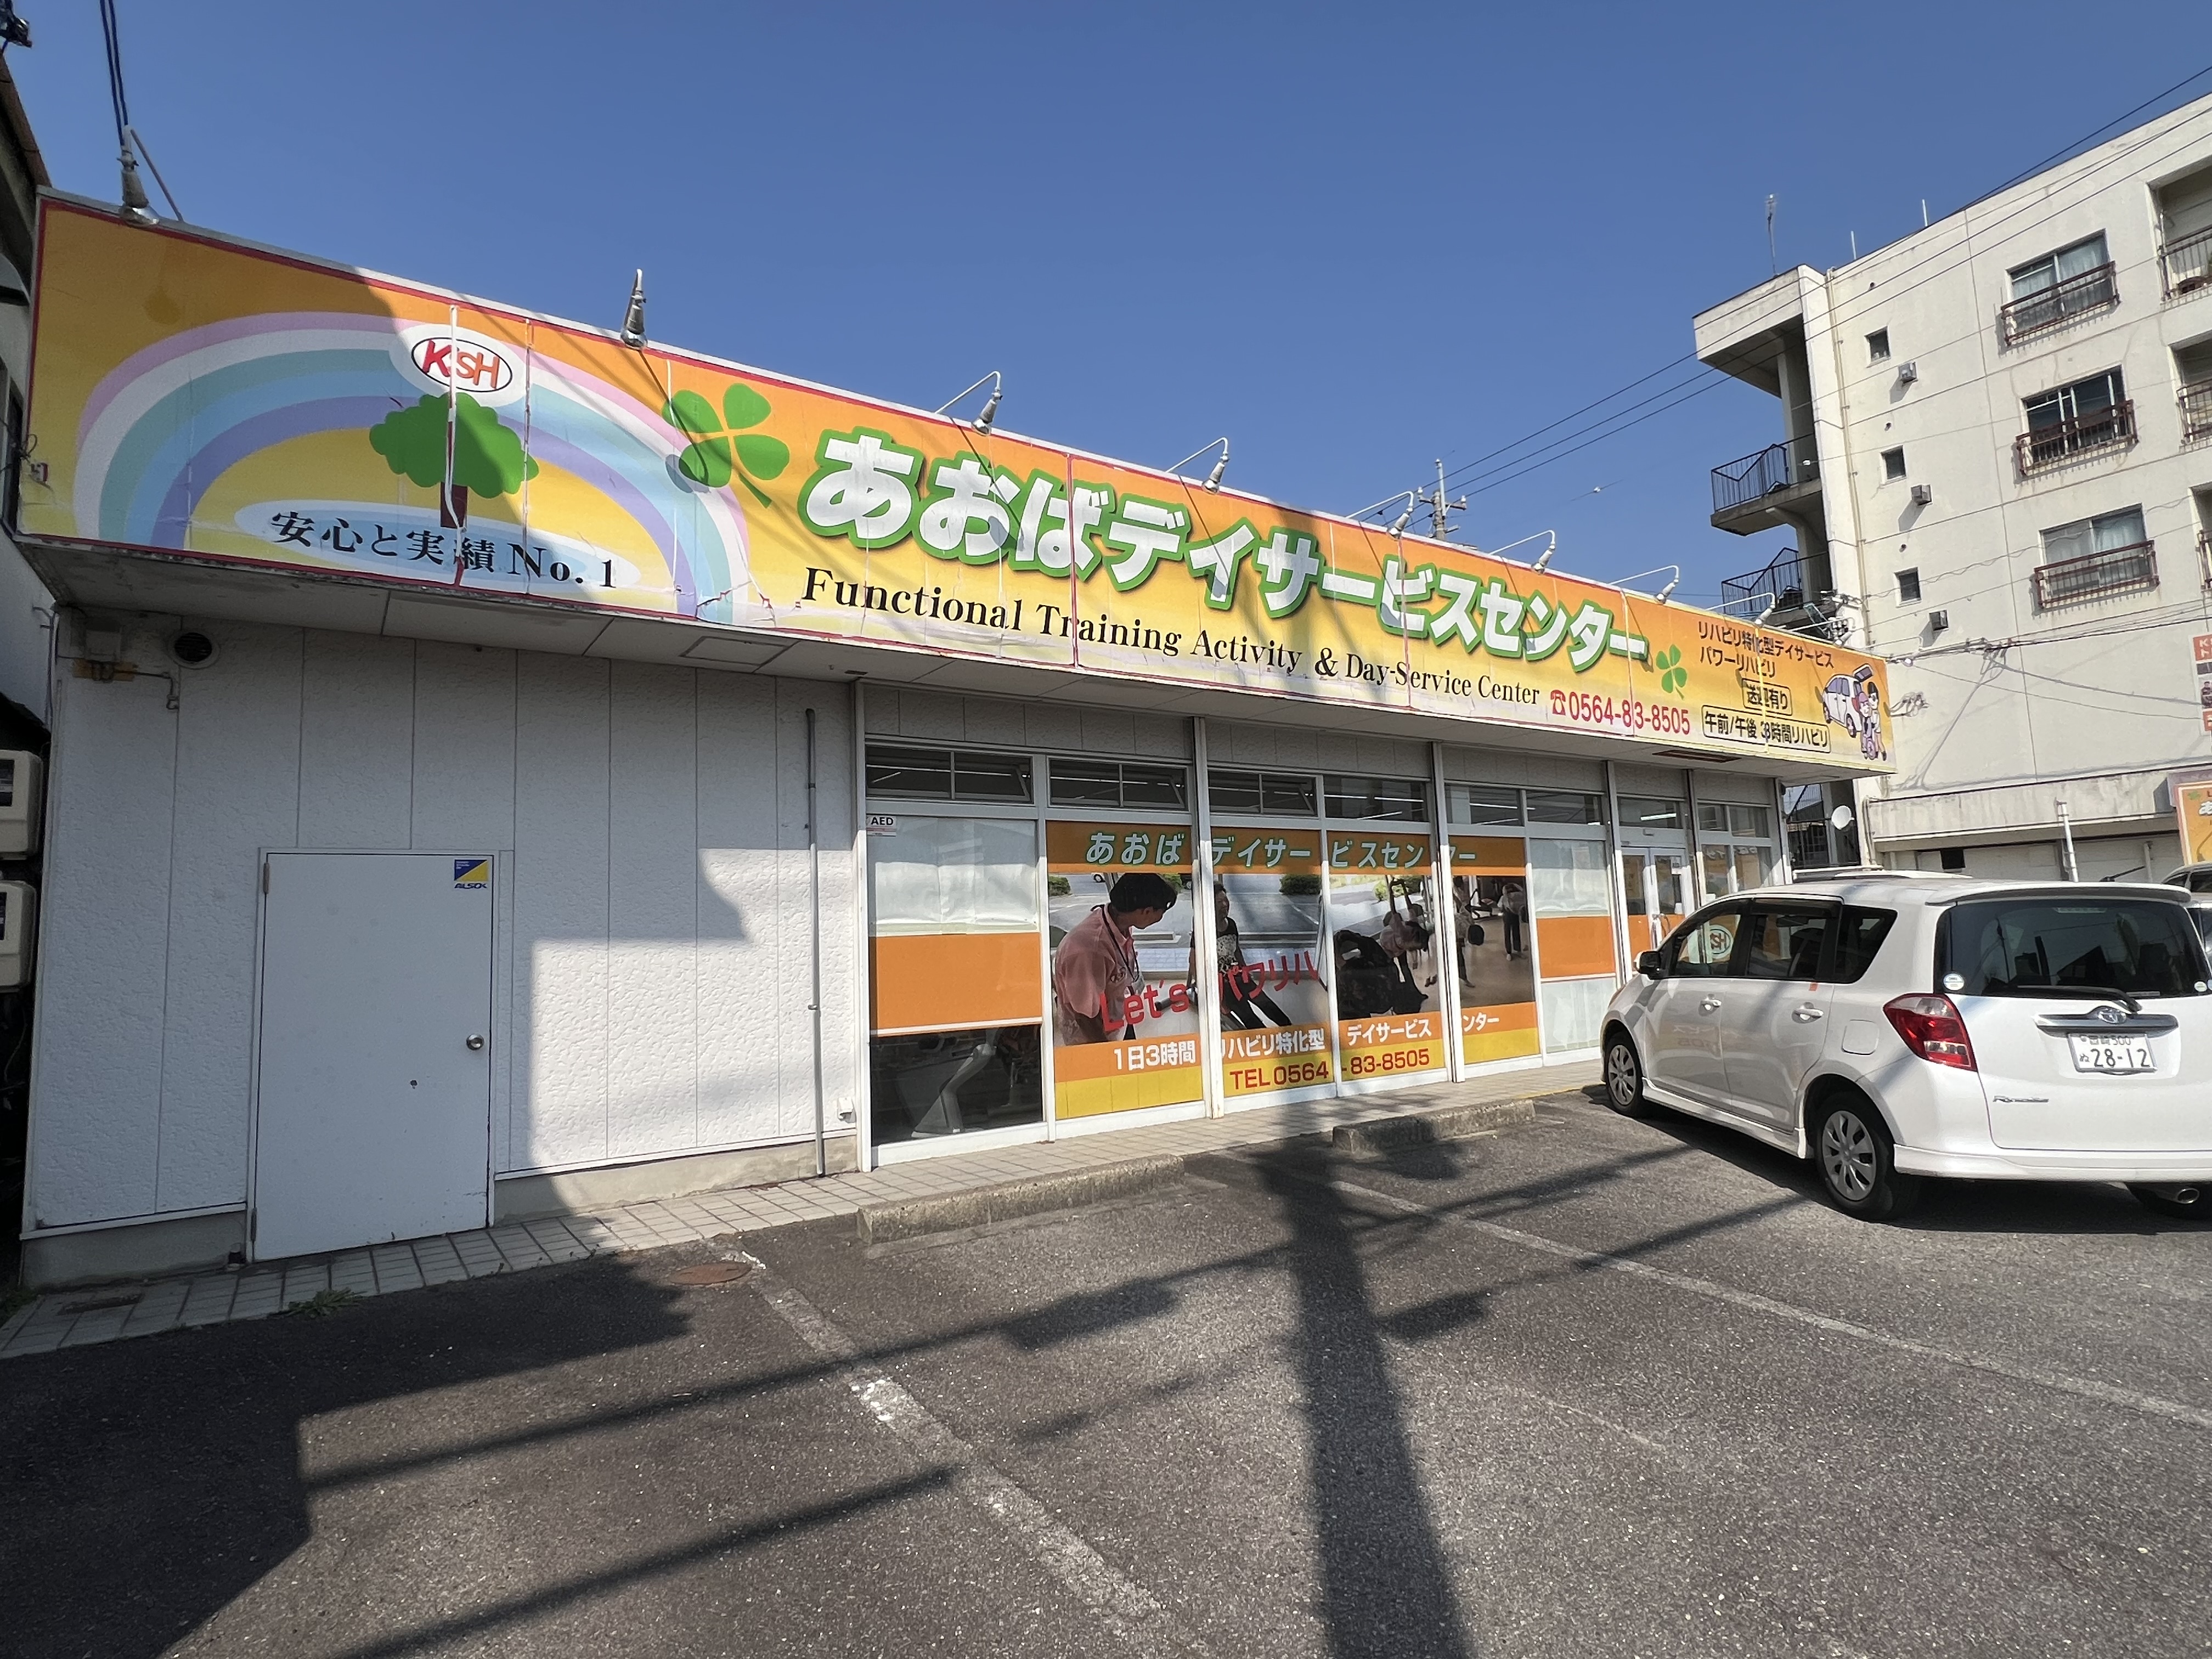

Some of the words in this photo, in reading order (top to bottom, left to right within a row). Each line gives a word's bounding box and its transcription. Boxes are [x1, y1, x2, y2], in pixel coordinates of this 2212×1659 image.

[272, 511, 495, 573] 安心と実績
[802, 431, 1647, 668] あおばデイサービスセンター
[803, 567, 1021, 631] Functional
[1036, 604, 1182, 656] Training
[1190, 630, 1302, 673] Activity
[1314, 647, 1339, 677] &
[1346, 653, 1471, 697] Day-Service
[1479, 676, 1540, 704] Center
[1699, 622, 1834, 668] リハビリ特化型デイサービス
[1700, 646, 1775, 678] パワーリハビリ
[1569, 691, 1690, 735] 0564-83-8505
[1705, 711, 1757, 738] 午前/午後
[871, 817, 894, 825] AED
[1086, 833, 1184, 864] あおば
[1212, 837, 1310, 867] デイサー
[1331, 840, 1423, 868] ビスセン
[1100, 980, 1189, 1032] Let's
[1114, 1040, 1196, 1071] 1日3時間
[1347, 1019, 1431, 1046] デイサービス
[2091, 1048, 2150, 1068] 28-12
